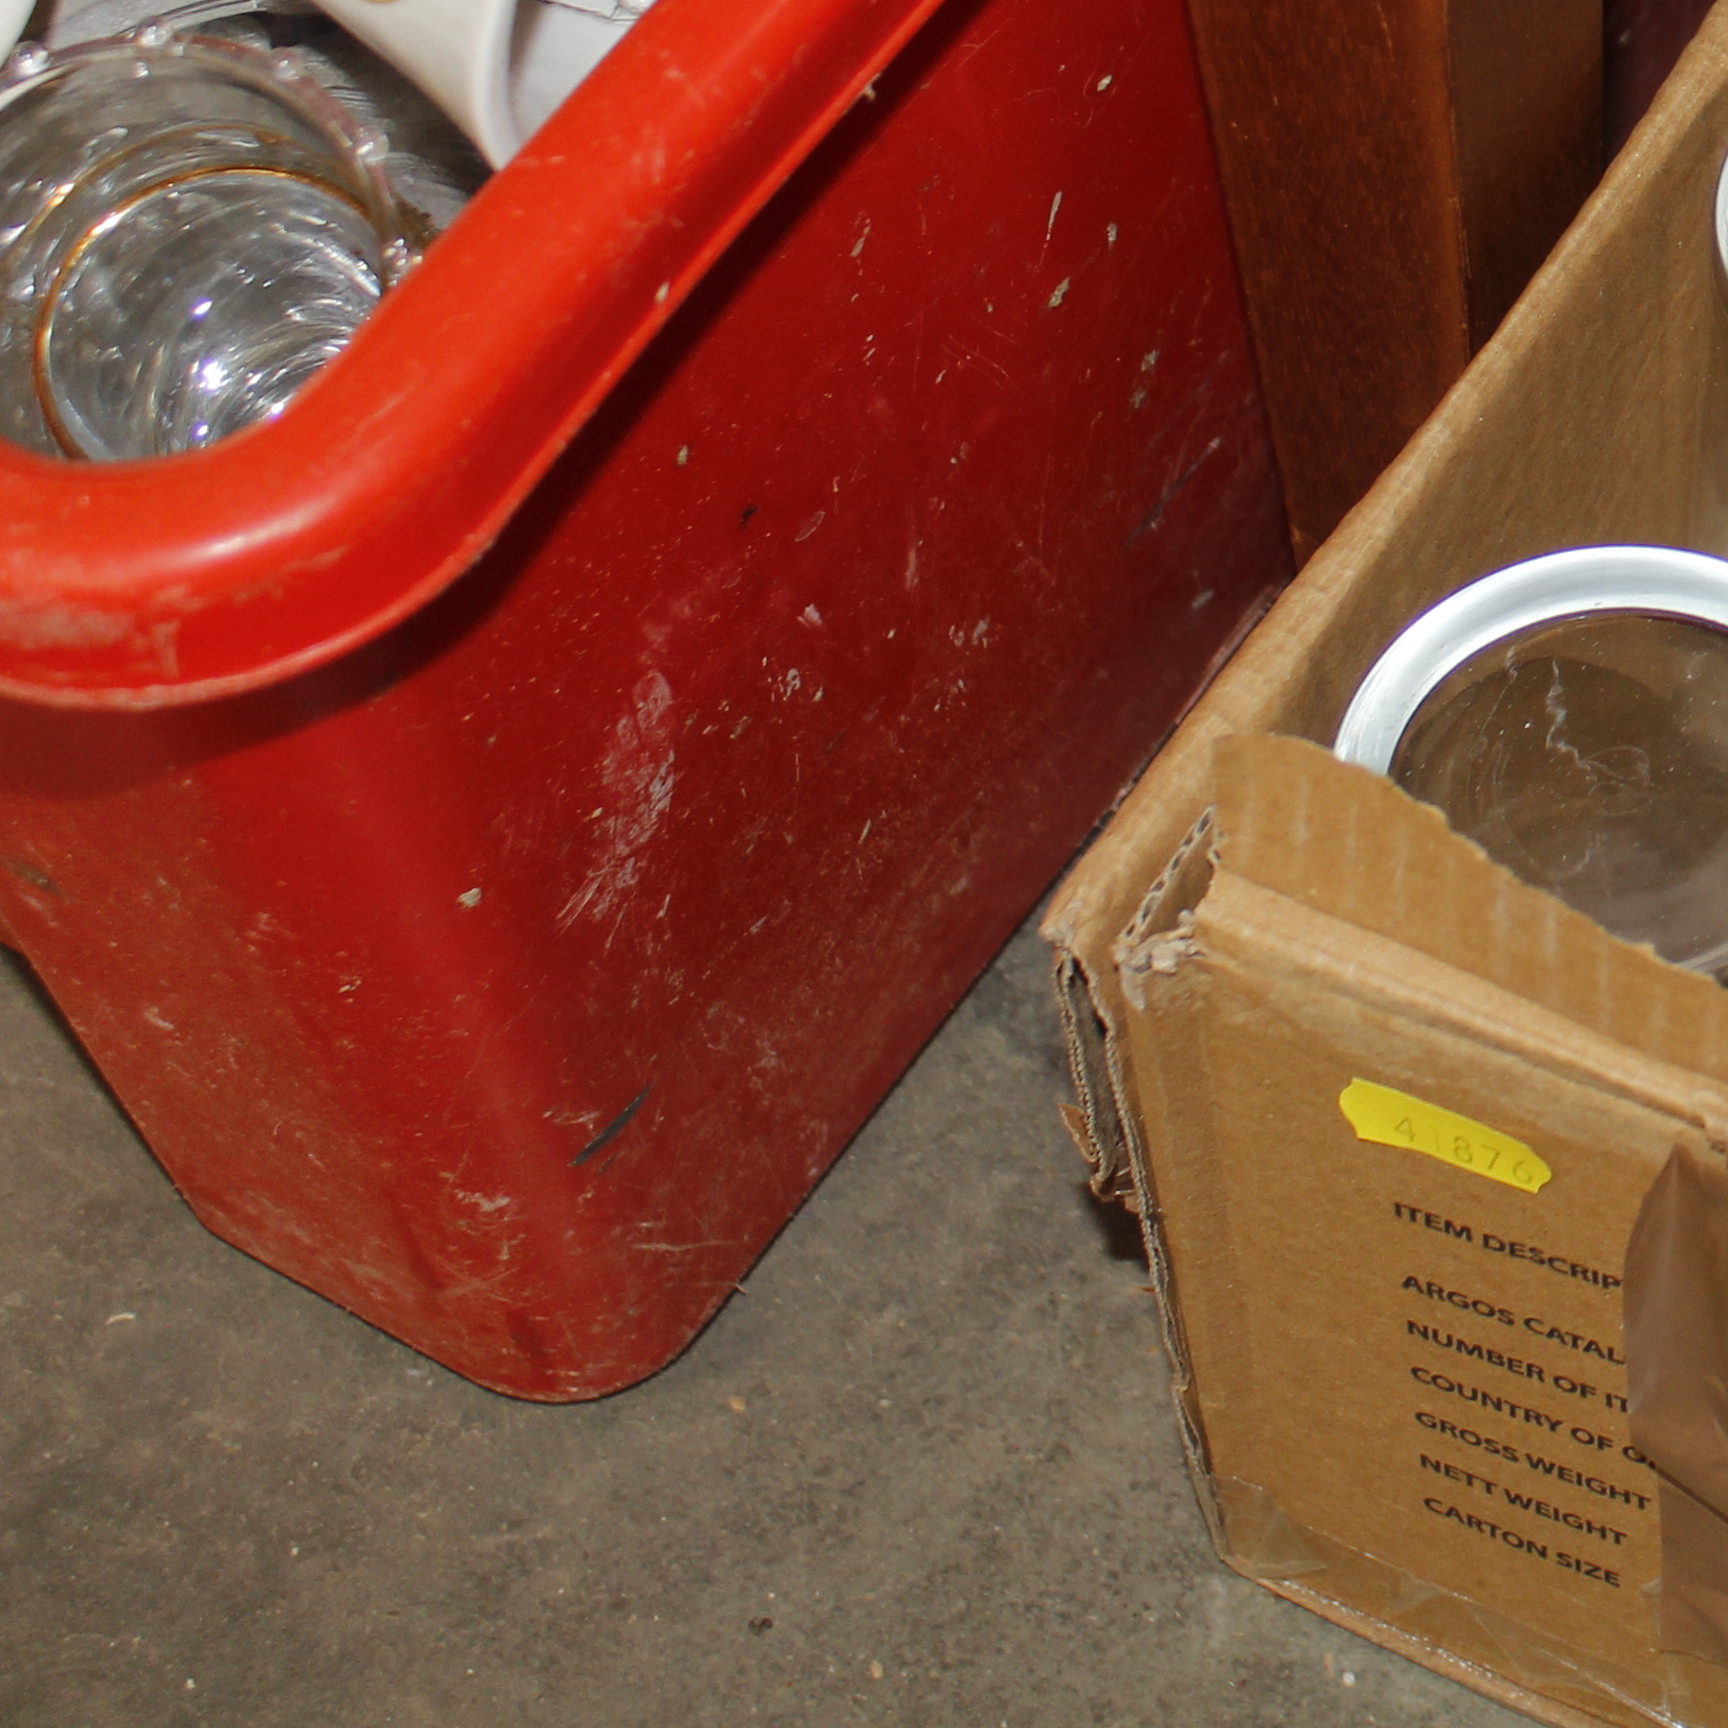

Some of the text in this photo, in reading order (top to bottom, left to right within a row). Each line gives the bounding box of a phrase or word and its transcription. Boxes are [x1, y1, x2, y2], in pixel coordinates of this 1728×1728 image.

[1393, 1202, 1623, 1289] ITEM DESCRIP
[1402, 1275, 1627, 1365] ARGOS CATAL
[1406, 1320, 1545, 1383] NUMBER
[1553, 1375, 1597, 1399] OF
[1410, 1366, 1563, 1433] COUNTRY
[1570, 1427, 1614, 1451] OF
[1415, 1411, 1652, 1510] GROSS WEIGHT
[1419, 1454, 1628, 1545] NETT WEIGHT
[1423, 1497, 1621, 1588] CARTON SIZE
